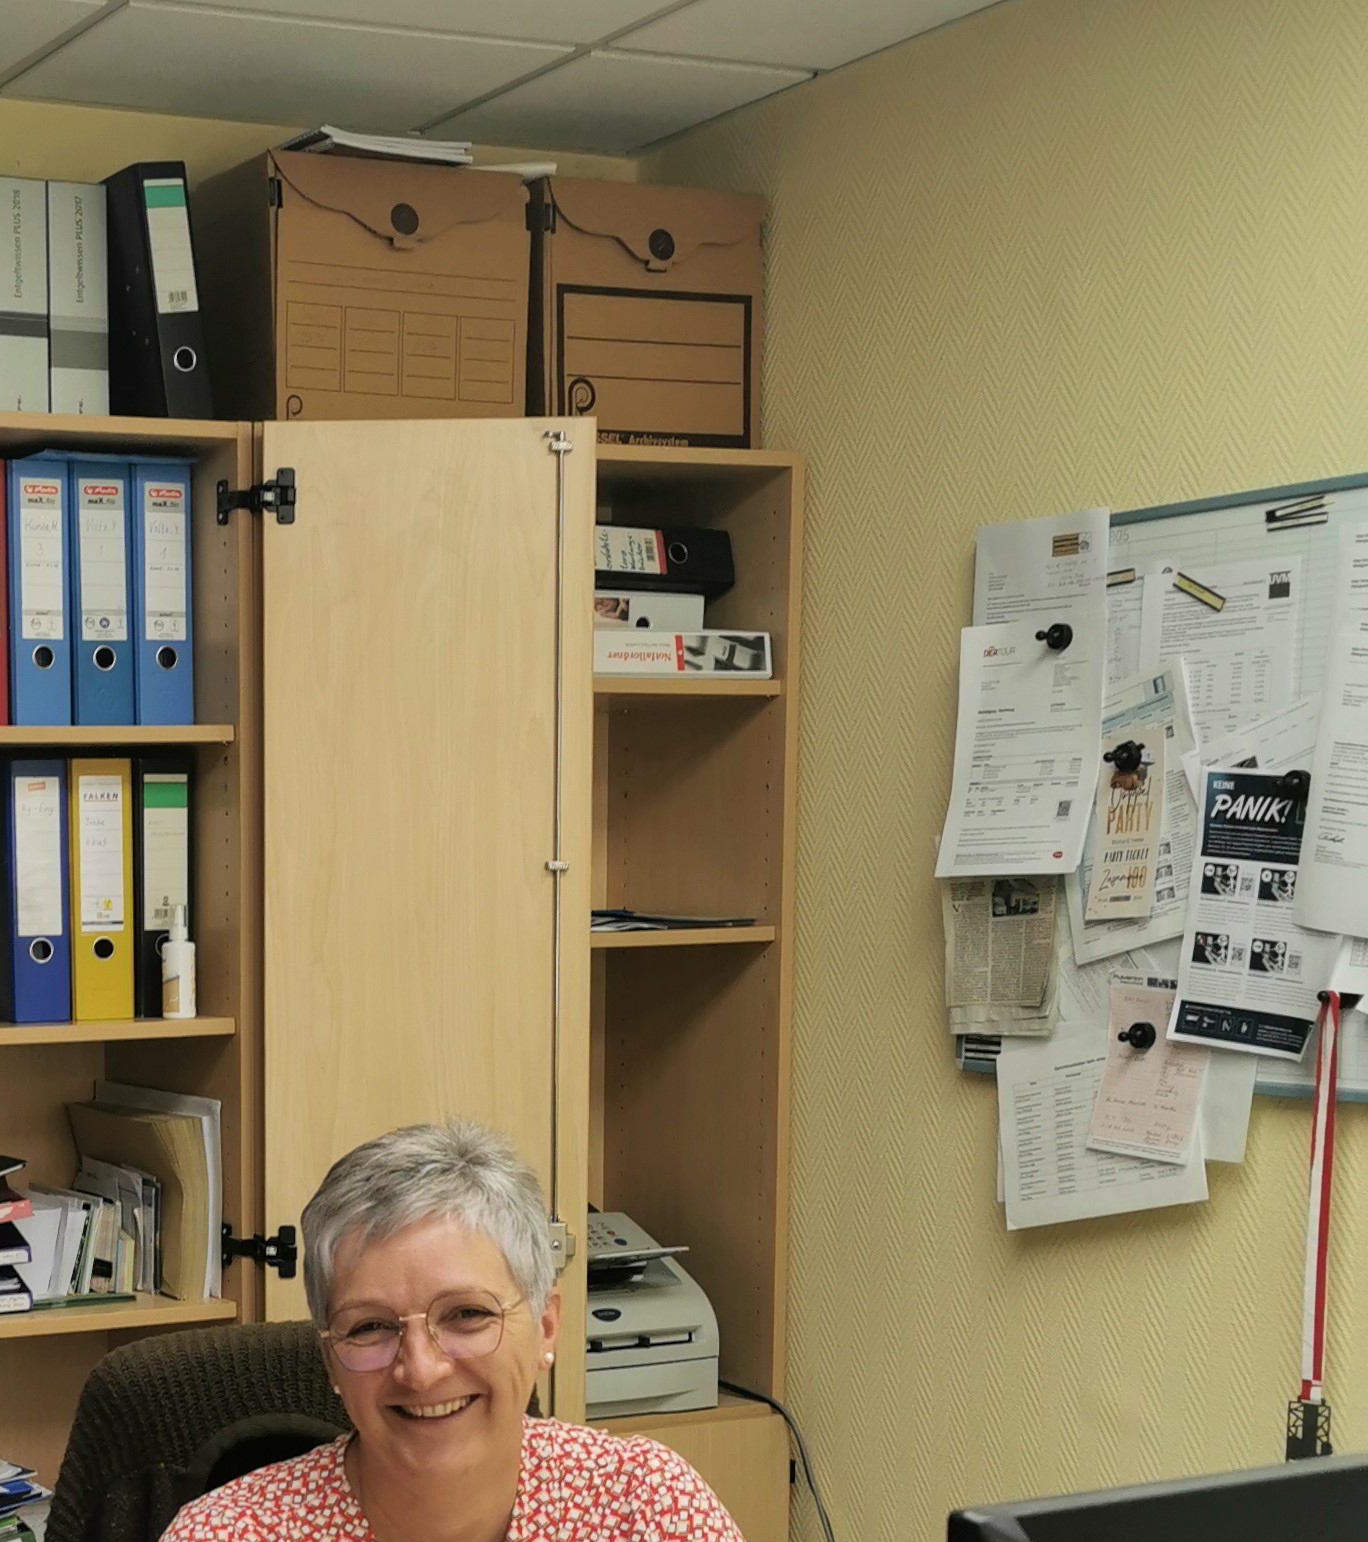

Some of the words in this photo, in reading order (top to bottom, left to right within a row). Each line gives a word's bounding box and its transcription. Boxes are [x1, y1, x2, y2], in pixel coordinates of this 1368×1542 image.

[74, 196, 83, 218] 2017
[13, 213, 21, 234] PLUS
[75, 219, 83, 240] PLUS
[13, 236, 23, 298] Entgeltwissen
[76, 243, 85, 303] Entgeltwissen
[1213, 780, 1235, 790] KEINE
[1107, 801, 1153, 835] PARTY
[1210, 794, 1293, 823] PANIK!
